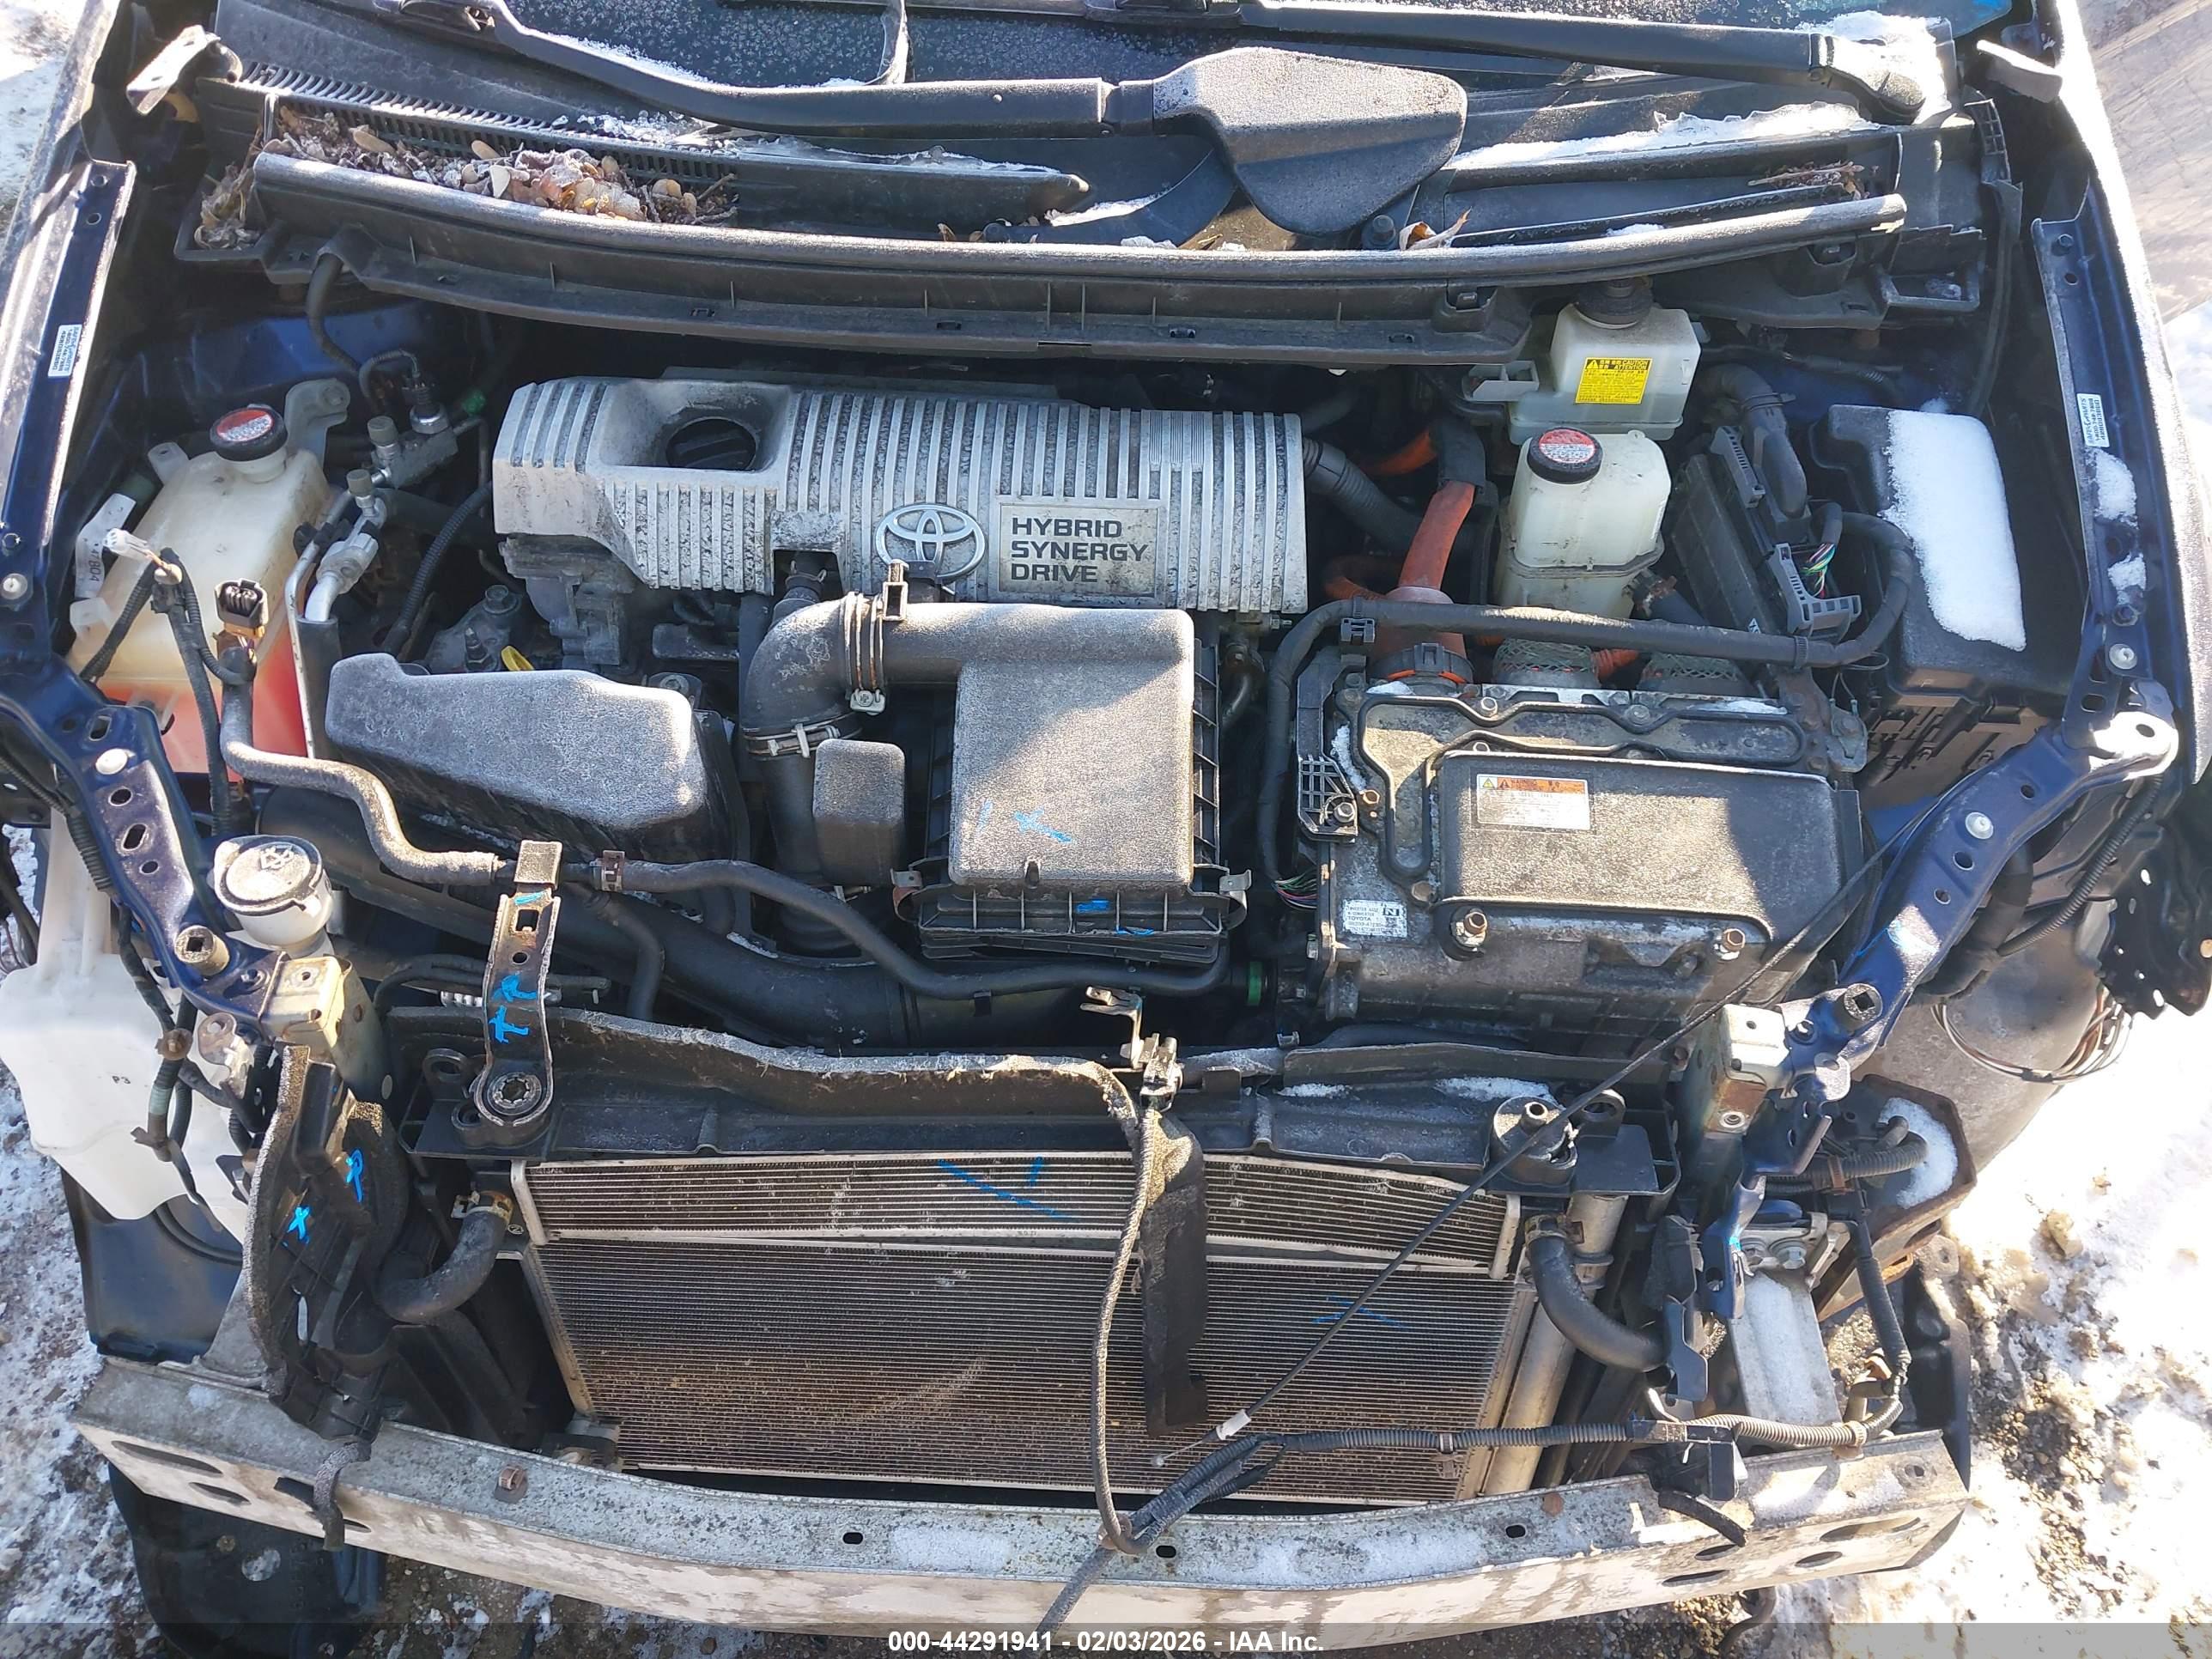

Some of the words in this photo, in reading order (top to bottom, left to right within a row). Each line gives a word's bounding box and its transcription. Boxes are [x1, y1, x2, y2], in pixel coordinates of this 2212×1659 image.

[1012, 517, 1122, 538] HYBRID
[1011, 540, 1149, 562] SYNERGY
[1011, 562, 1098, 583] DRIVE
